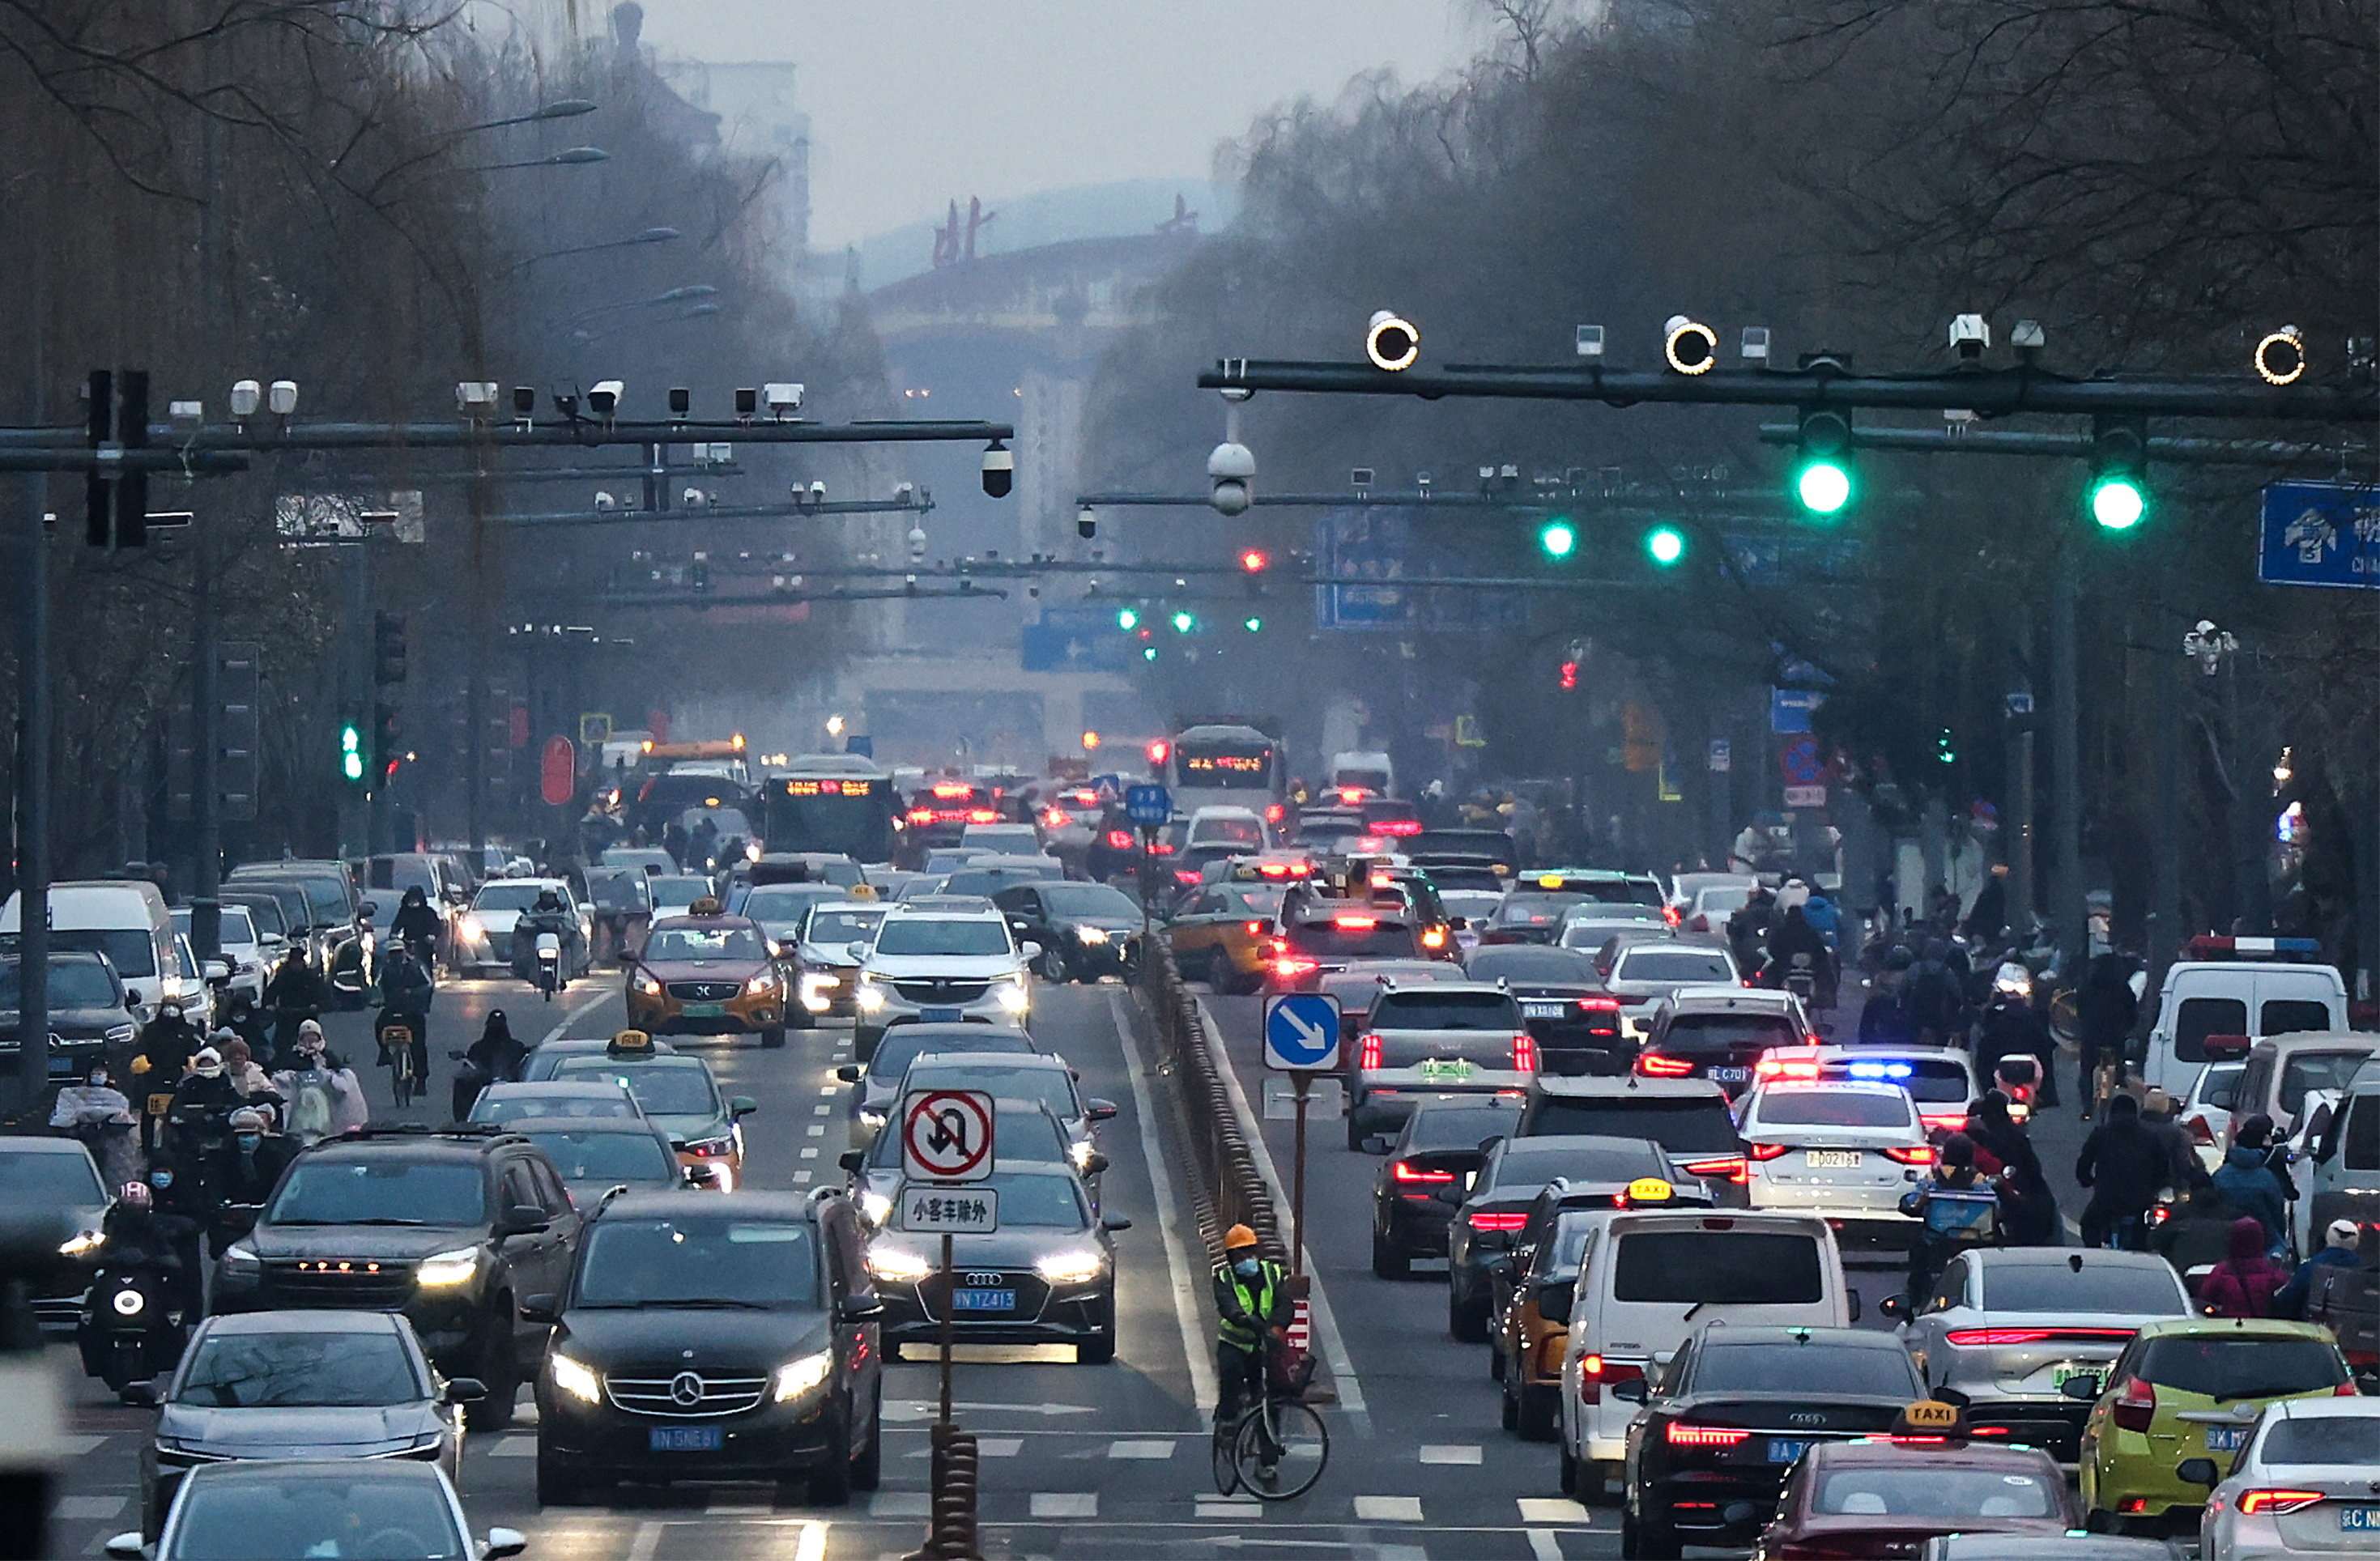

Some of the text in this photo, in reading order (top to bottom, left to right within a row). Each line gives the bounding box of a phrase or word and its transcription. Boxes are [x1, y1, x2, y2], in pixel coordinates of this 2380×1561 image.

[1635, 1185, 1665, 1193] TAXI
[913, 1197, 987, 1223] 小客车除外
[1914, 1408, 1951, 1422] TAXI
